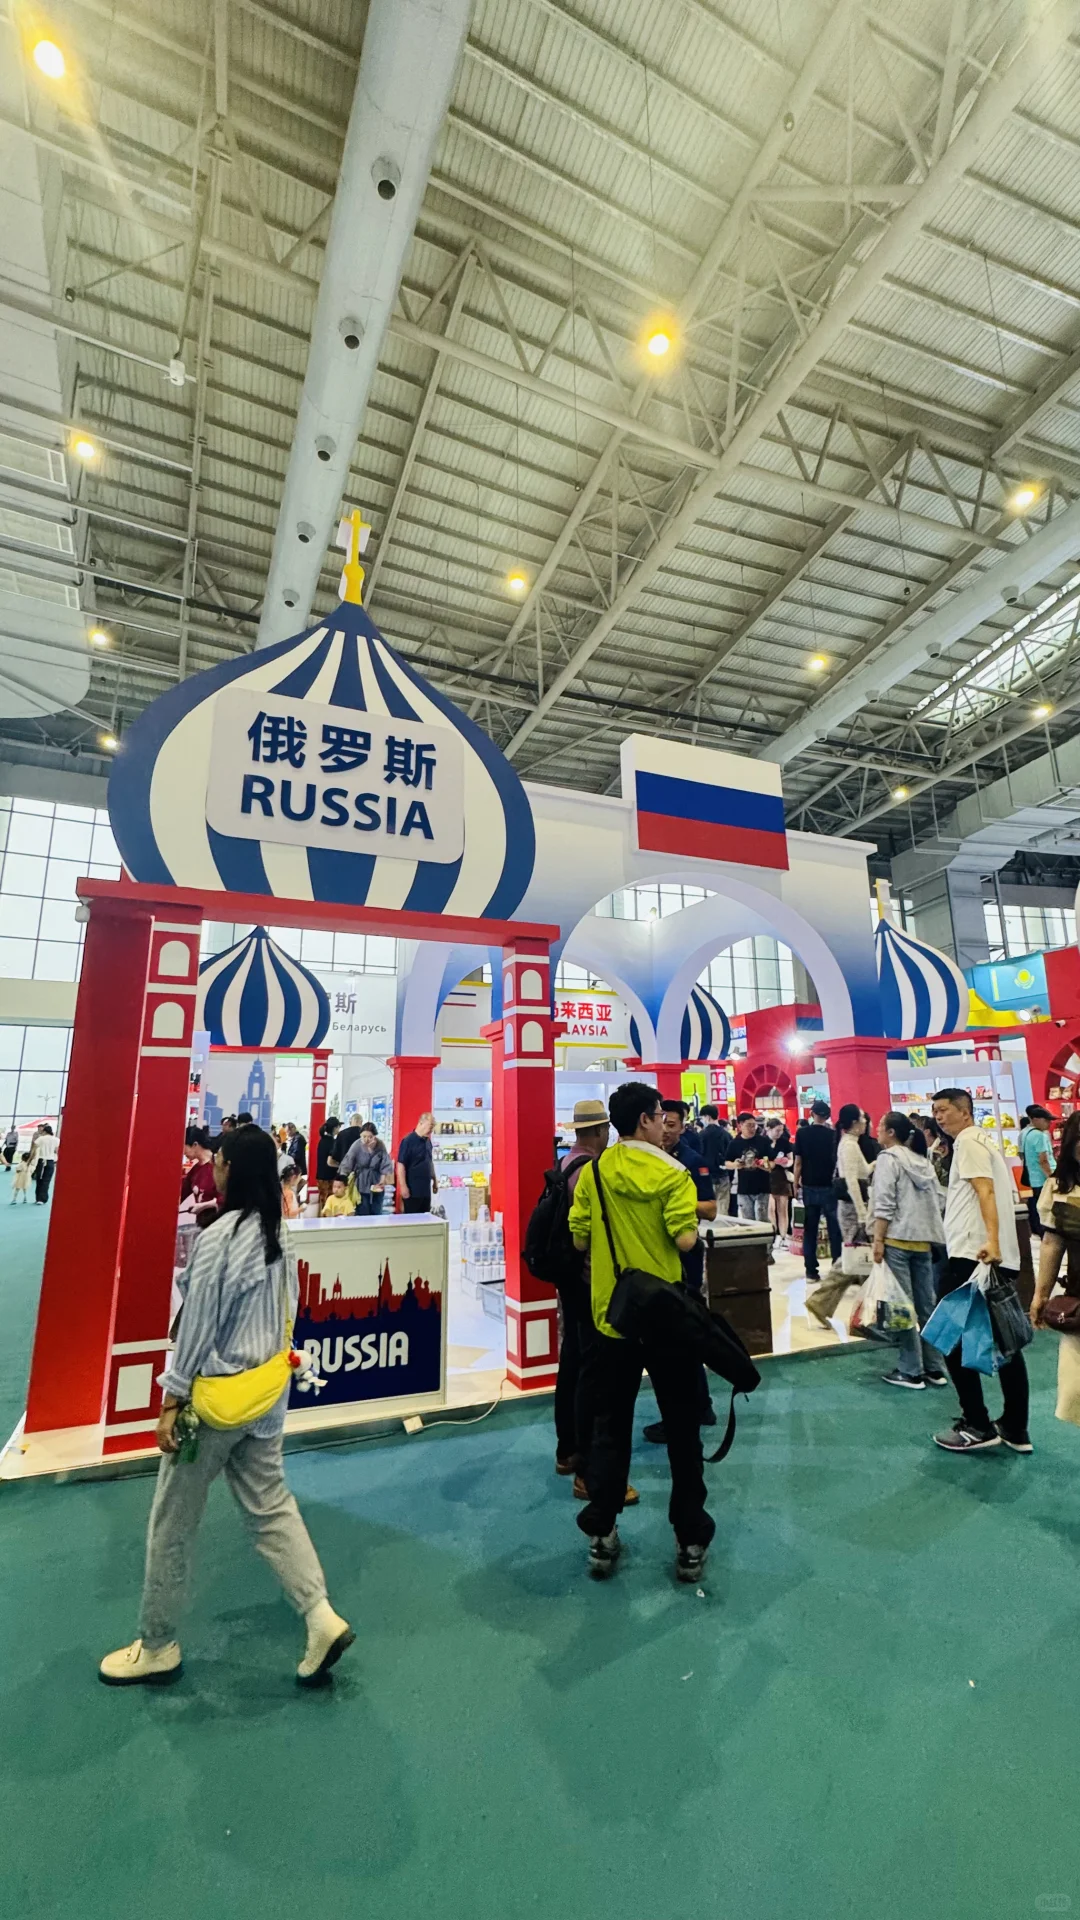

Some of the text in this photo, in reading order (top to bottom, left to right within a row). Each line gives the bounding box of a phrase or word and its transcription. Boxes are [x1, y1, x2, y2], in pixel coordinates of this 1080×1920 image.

[247, 711, 437, 790] 俄罗斯
[240, 774, 434, 840] RUSSIA
[327, 992, 357, 1014] 斯
[332, 1021, 387, 1034] Беларусь
[566, 1024, 608, 1036] AYSIA
[304, 1331, 409, 1376] RUSSIA
